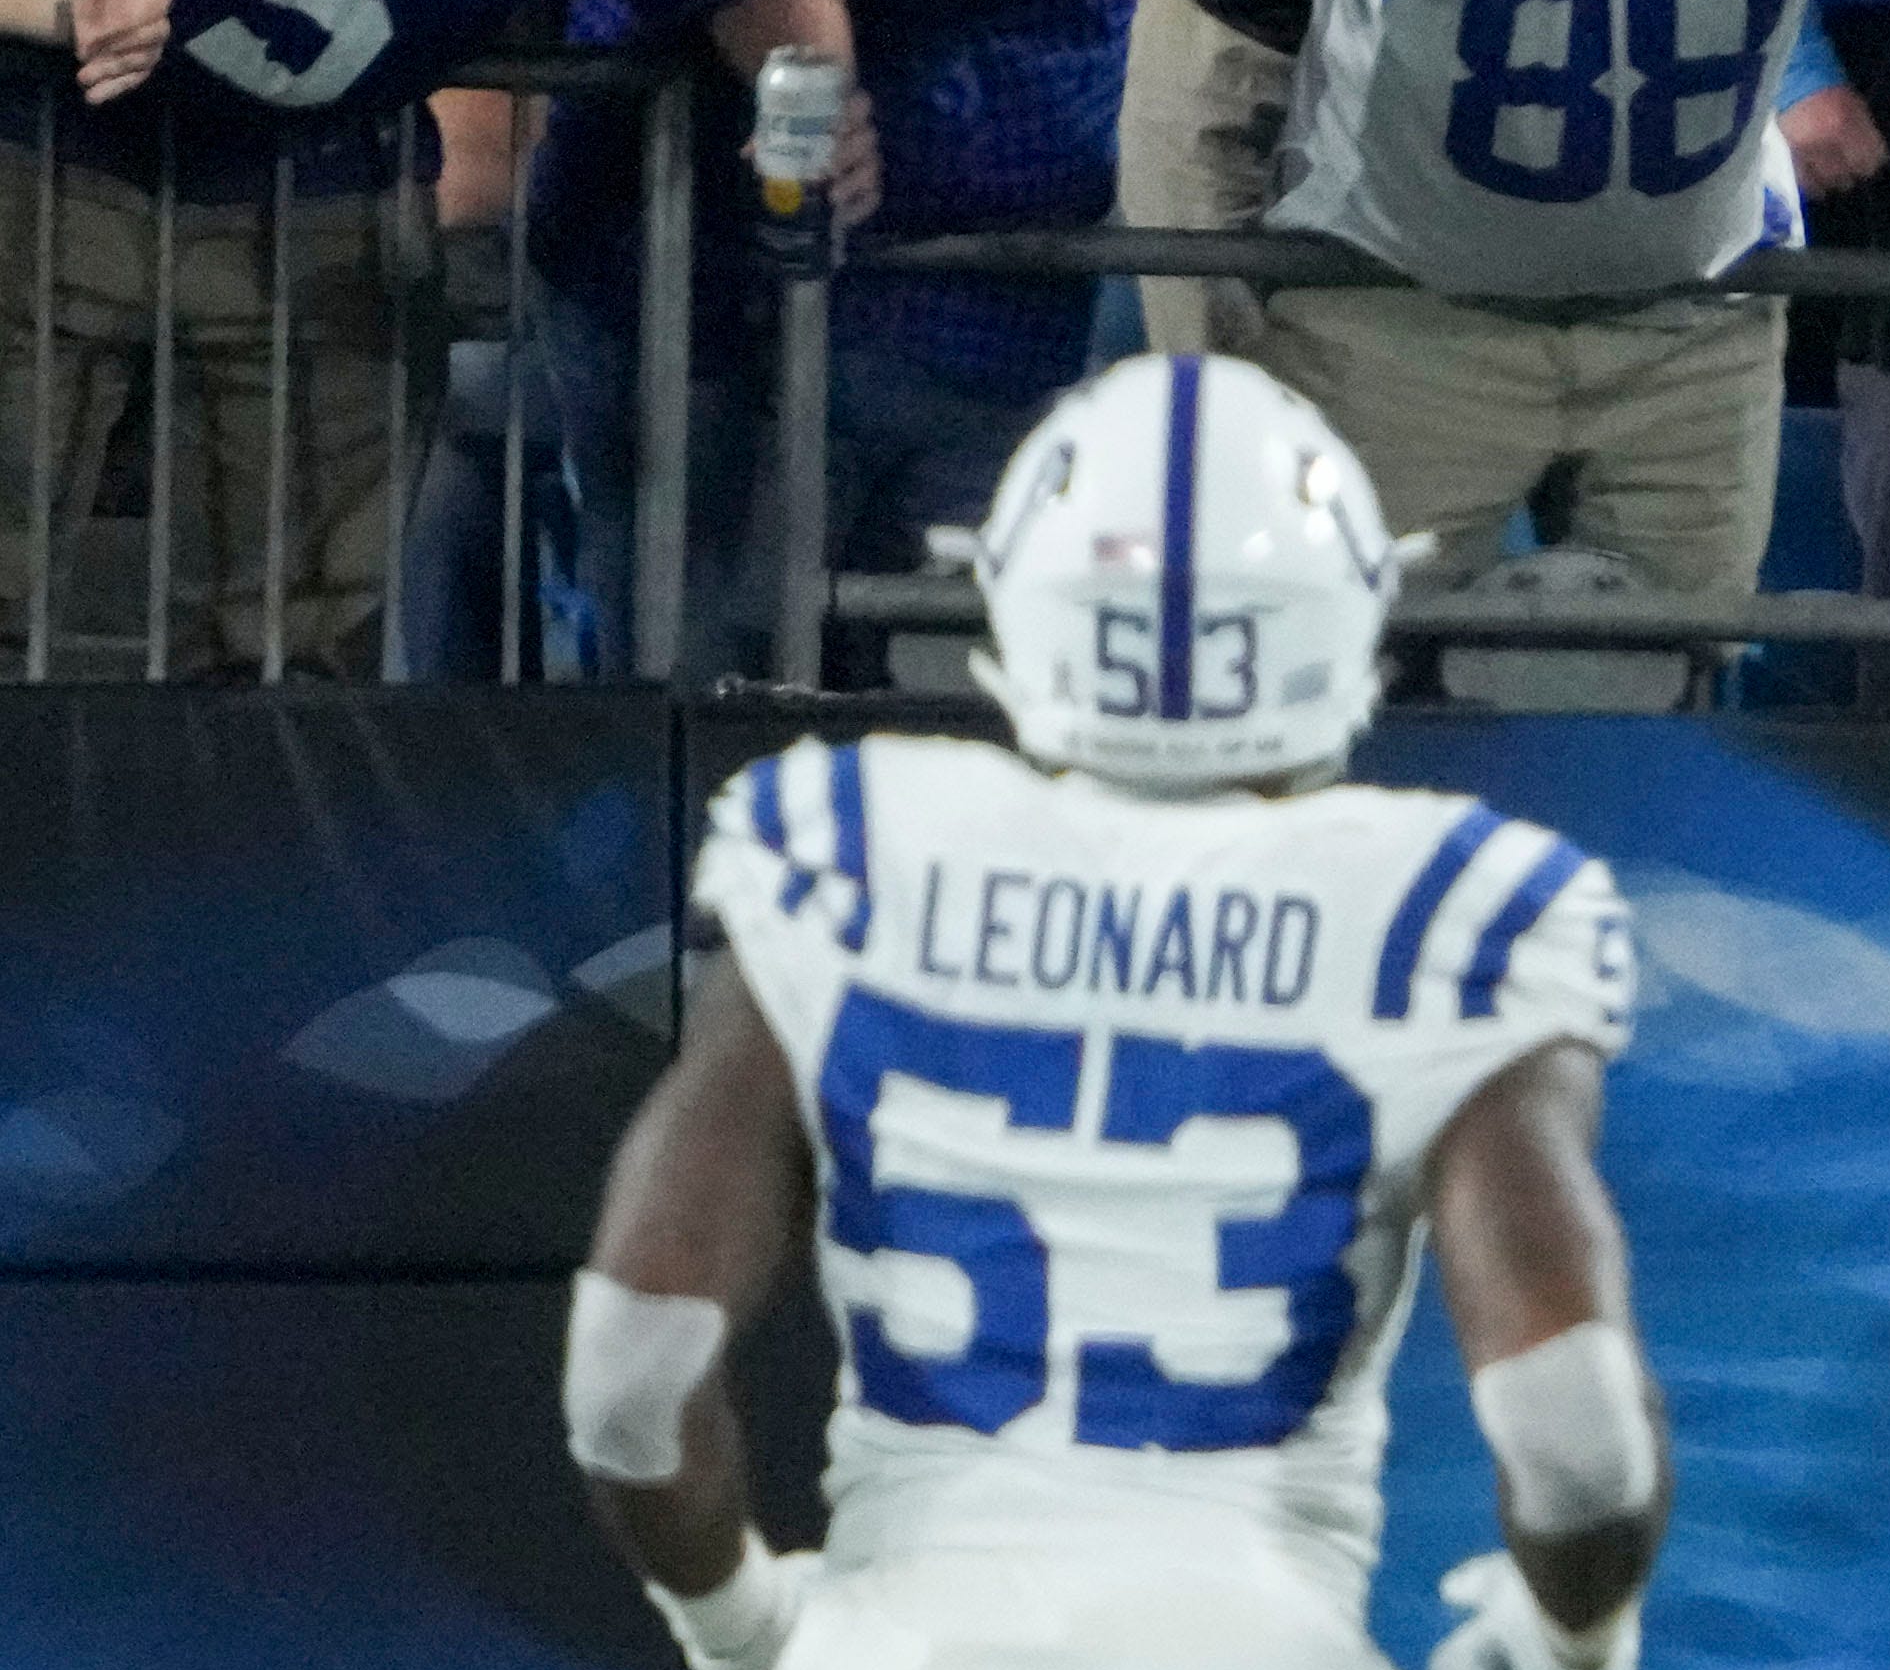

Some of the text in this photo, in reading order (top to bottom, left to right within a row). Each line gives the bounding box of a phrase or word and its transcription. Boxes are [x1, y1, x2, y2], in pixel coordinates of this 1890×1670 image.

[1094, 607, 1258, 719] 53
[918, 859, 1321, 1009] LEONARD
[818, 983, 1375, 1453] 53
